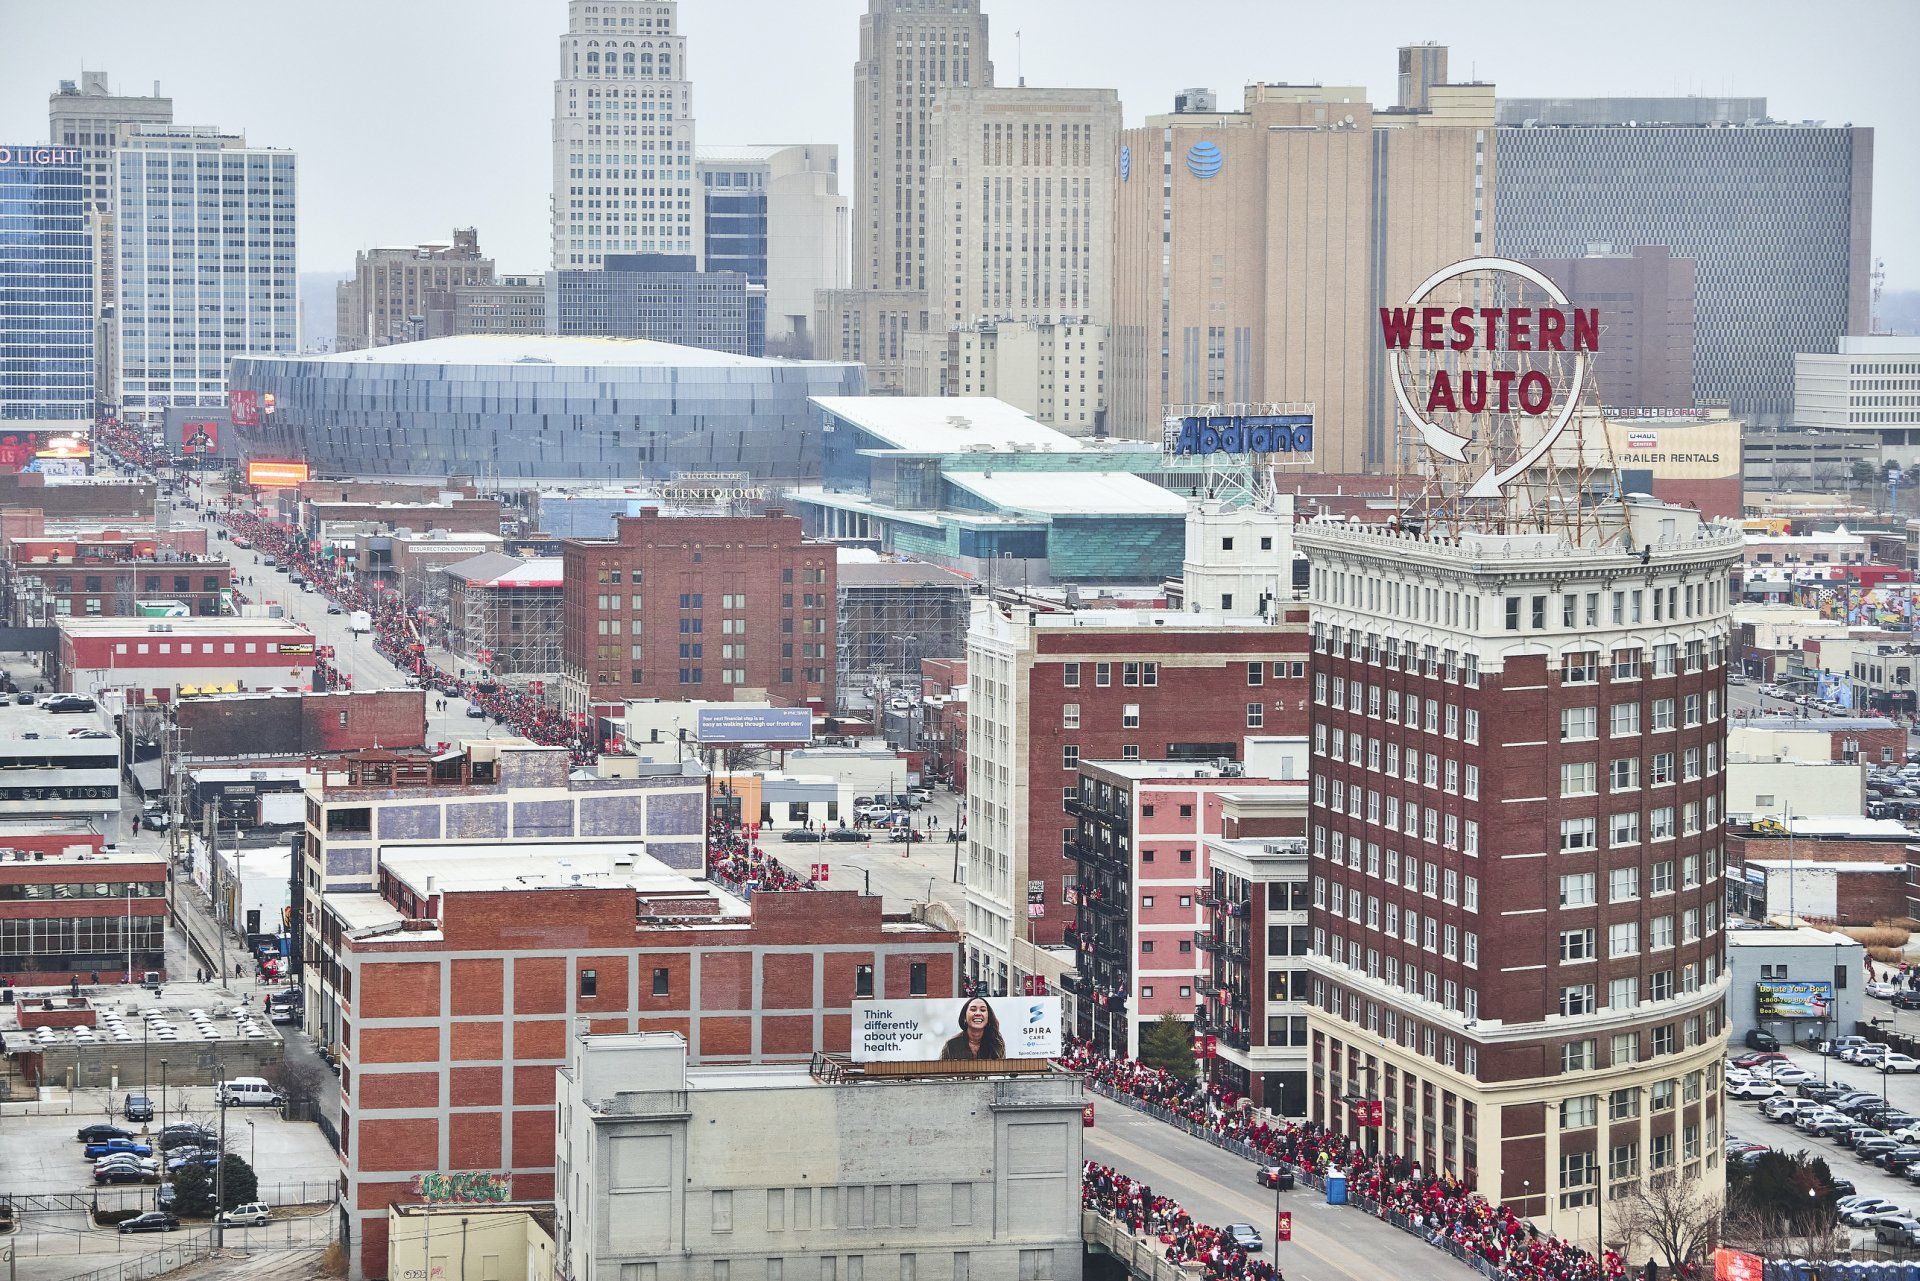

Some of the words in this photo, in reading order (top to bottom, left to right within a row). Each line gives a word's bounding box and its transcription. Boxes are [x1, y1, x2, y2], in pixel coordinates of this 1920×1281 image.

[18, 149, 78, 164] LIGHT
[1379, 306, 1600, 352] WESTERN
[1426, 369, 1553, 416] AUTO
[1175, 414, 1314, 456] Abdiana
[1670, 453, 1720, 463] RENTALS
[655, 487, 766, 500] SCIENTOLOGY
[22, 787, 112, 799] STATION
[1760, 985, 1787, 993] Donate
[1789, 985, 1807, 993] Your
[1810, 985, 1828, 993] Boat
[864, 1009, 893, 1019] Think
[864, 1020, 919, 1031] differently
[1022, 1027, 1052, 1035] SPIRA
[864, 1032, 897, 1041] about
[899, 1033, 924, 1042] your
[864, 1042, 902, 1052] health.
